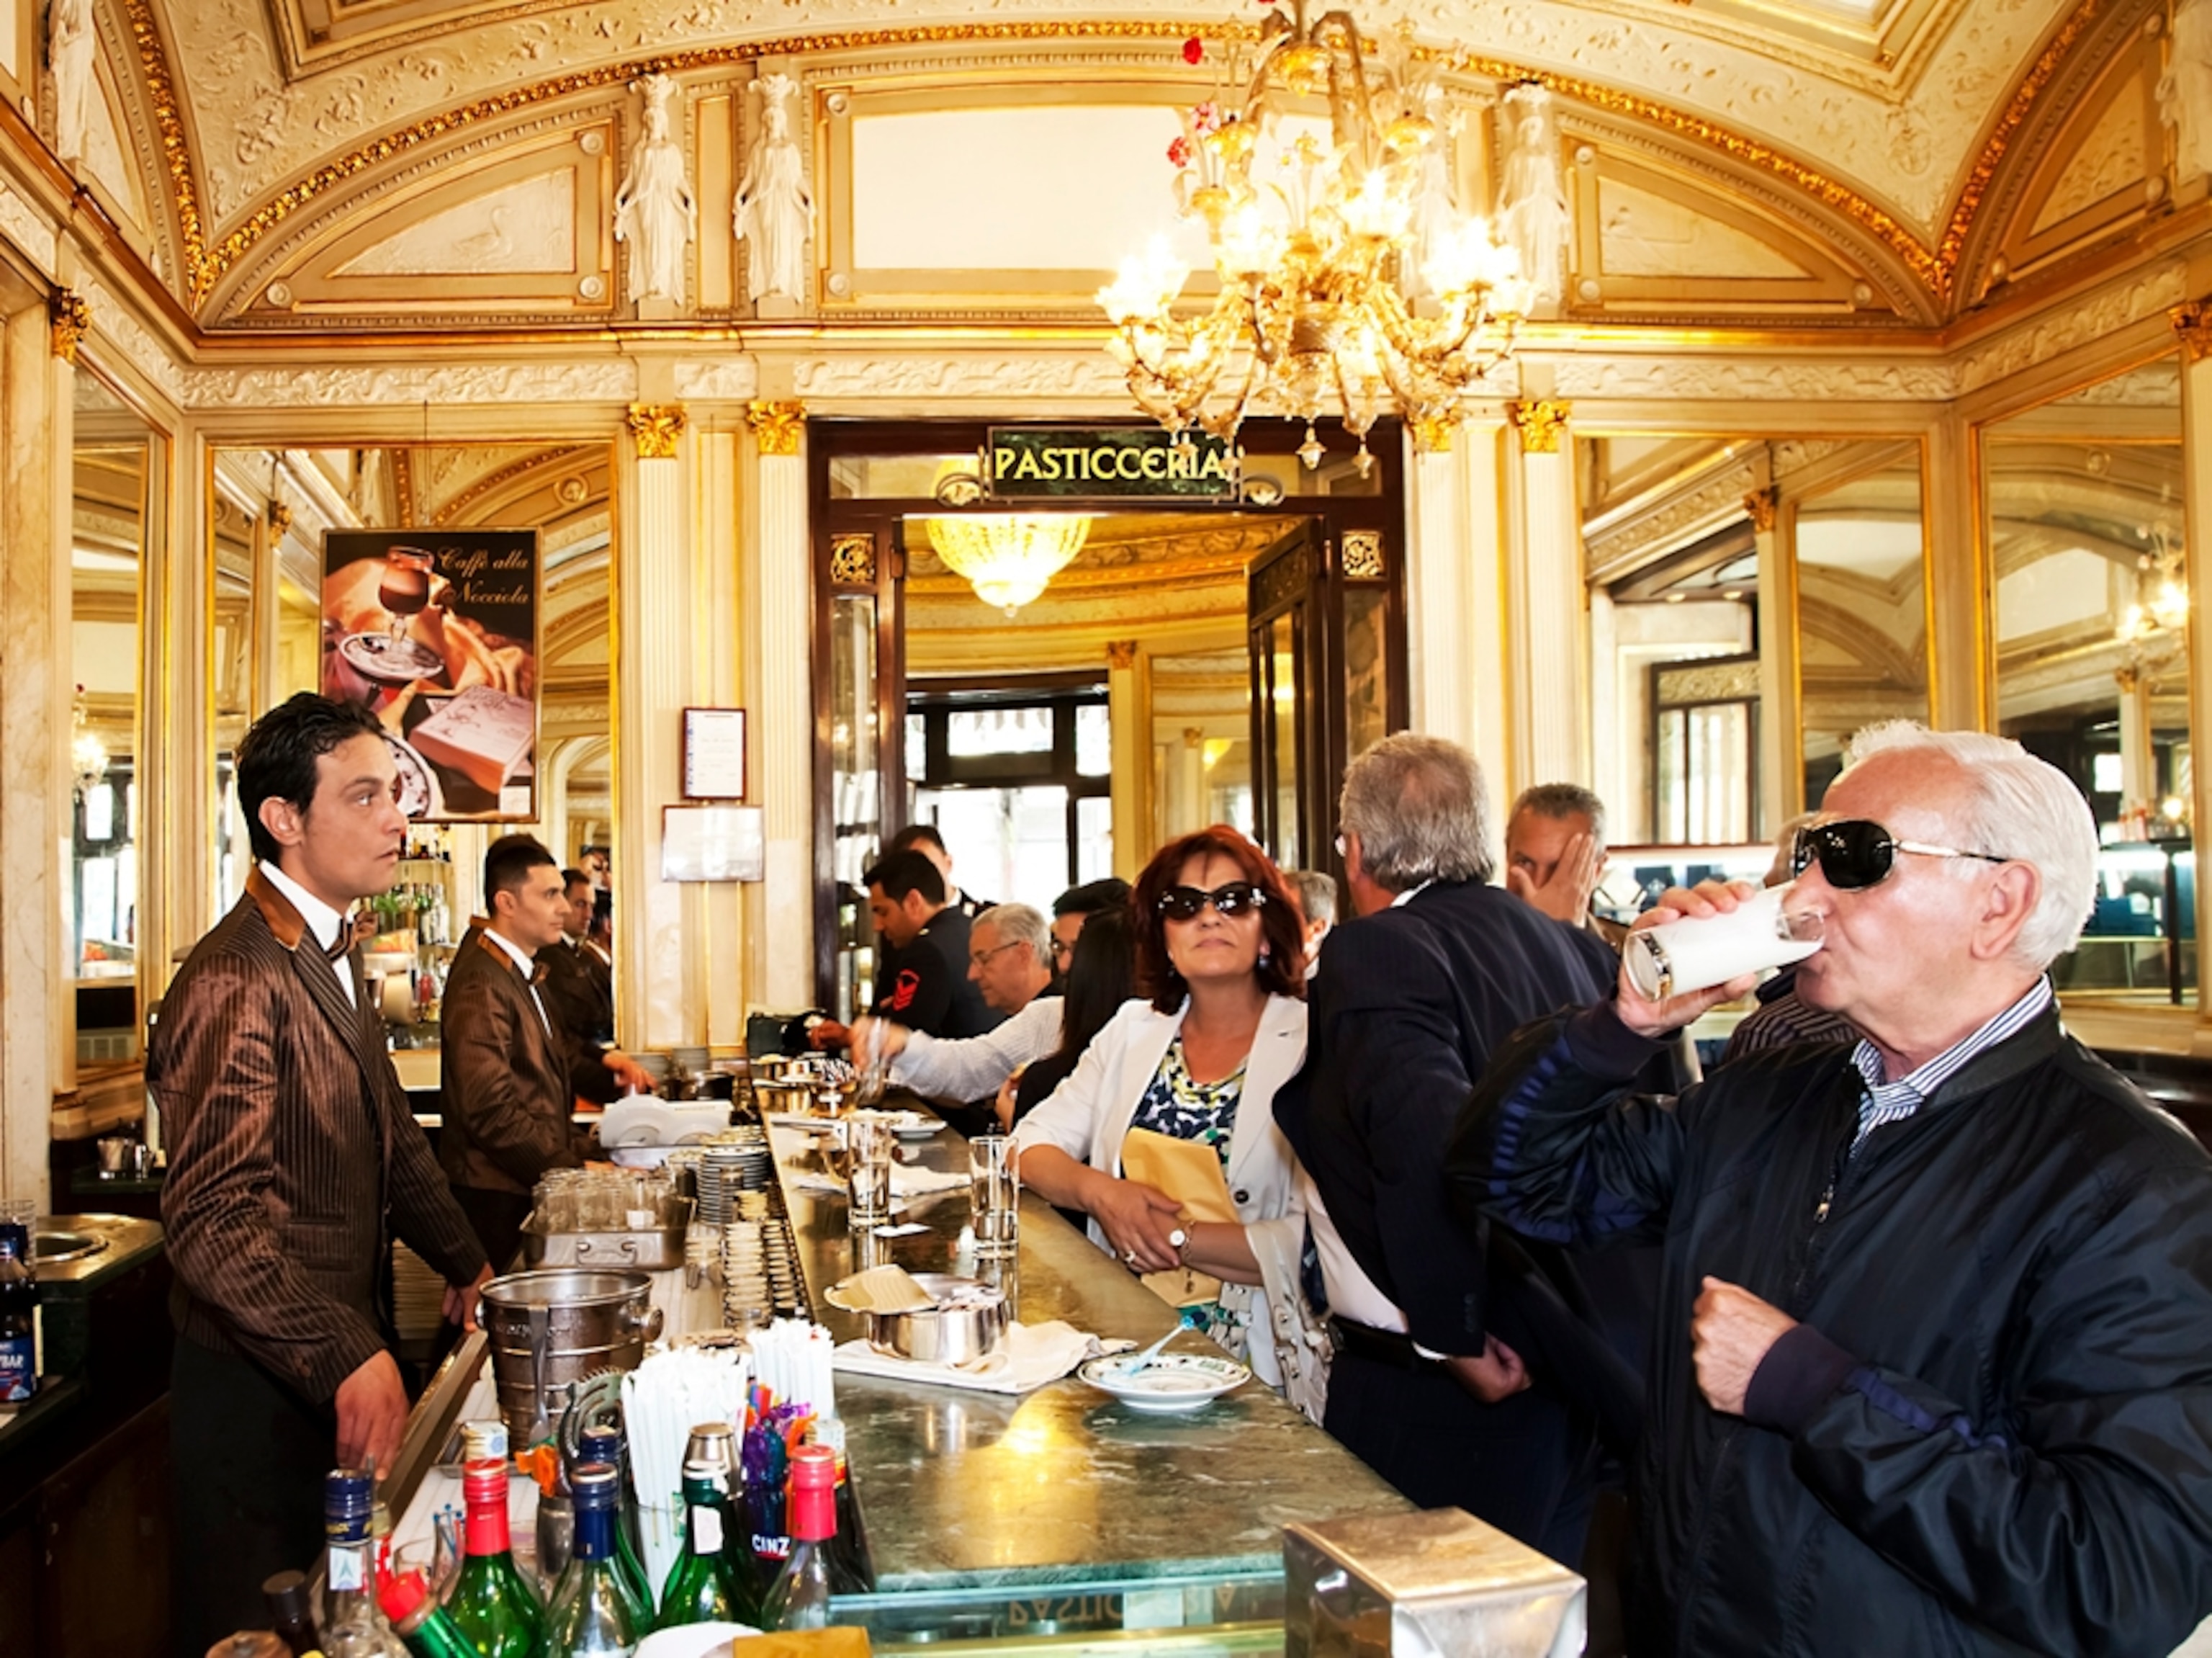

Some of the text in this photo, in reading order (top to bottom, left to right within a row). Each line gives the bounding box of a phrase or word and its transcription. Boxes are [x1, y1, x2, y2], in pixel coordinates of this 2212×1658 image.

[994, 448, 1226, 480] PASTICCERIA
[493, 550, 529, 569] alla
[456, 580, 529, 603] Nocciola
